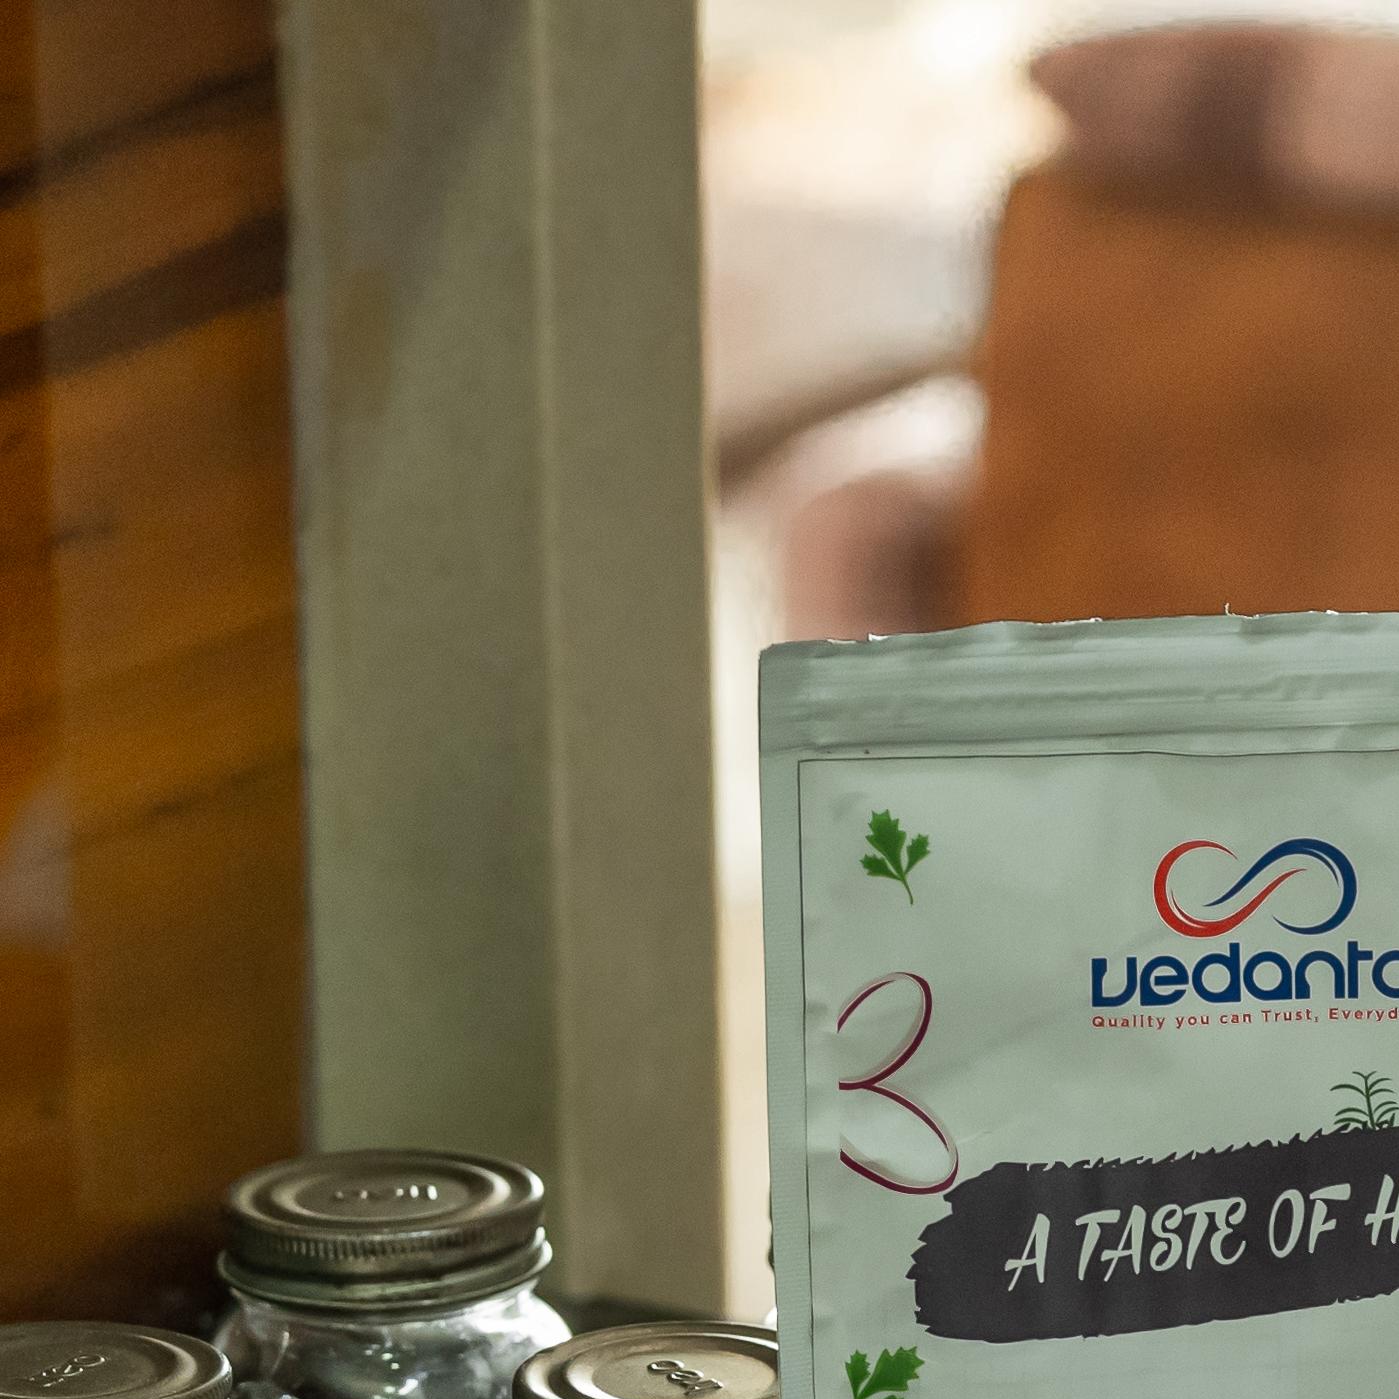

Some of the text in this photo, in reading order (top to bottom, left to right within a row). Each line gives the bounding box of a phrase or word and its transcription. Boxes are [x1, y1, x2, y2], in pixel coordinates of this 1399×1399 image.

[1091, 1013, 1166, 1031] Quality
[1175, 1012, 1210, 1029] you
[1219, 1010, 1252, 1025] can
[1261, 1008, 1319, 1024] Trust,
[1004, 1212, 1051, 1292] A
[1075, 1195, 1247, 1283] TASTE
[1268, 1182, 1352, 1259] OF
